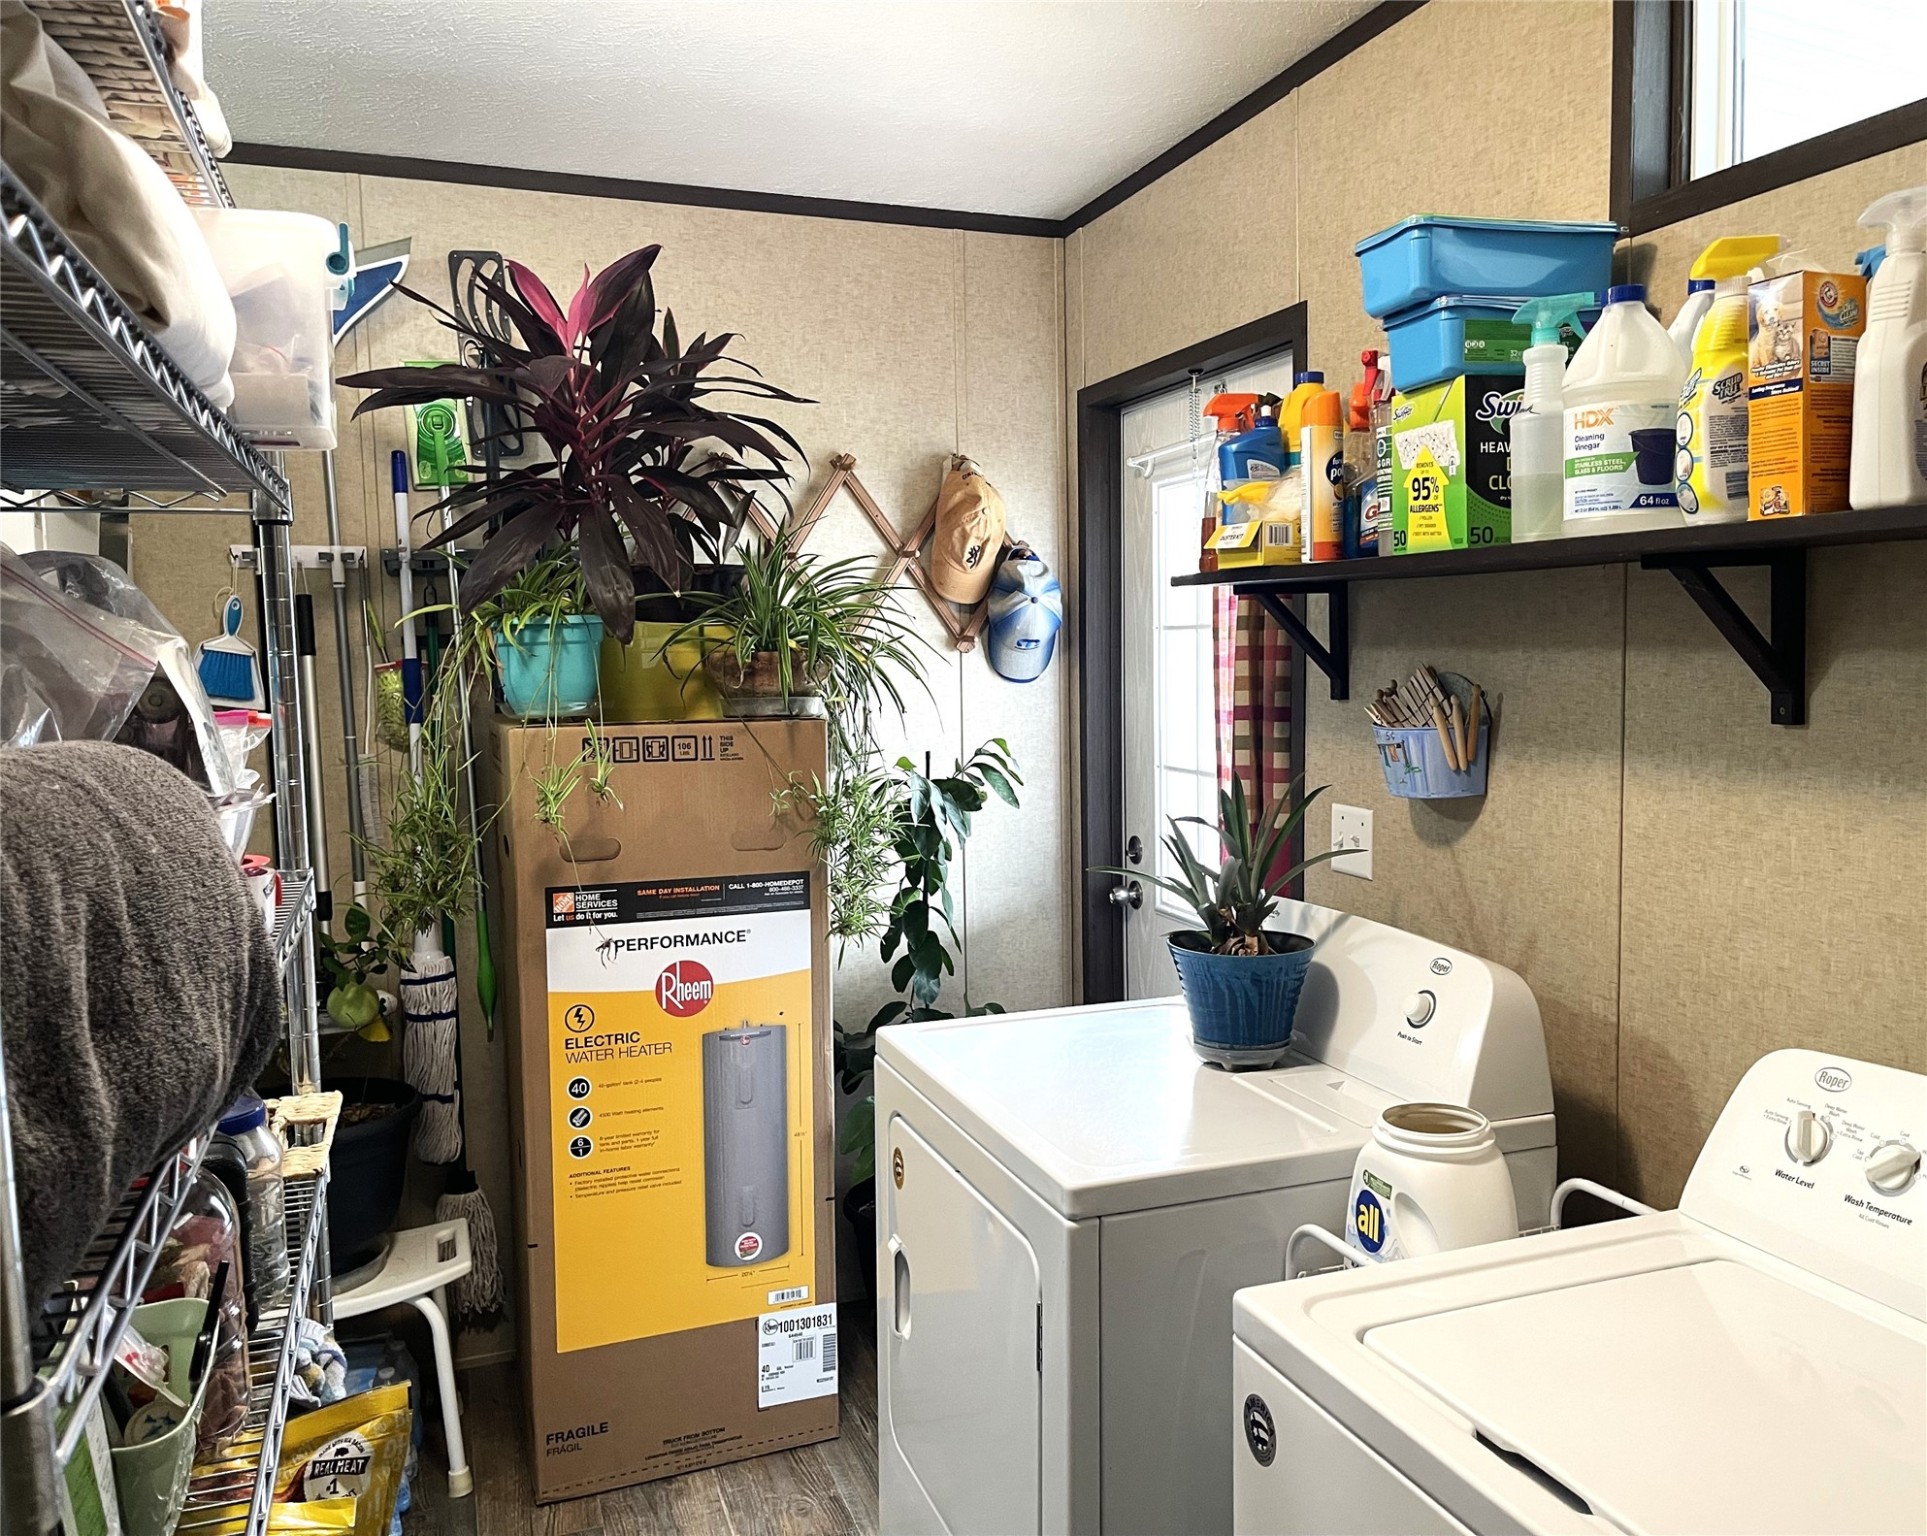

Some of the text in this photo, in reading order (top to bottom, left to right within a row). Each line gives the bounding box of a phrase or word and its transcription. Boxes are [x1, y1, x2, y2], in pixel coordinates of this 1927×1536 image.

[1574, 408, 1614, 430] HDX
[1574, 433, 1605, 444] Cleaning
[1574, 442, 1600, 452] Vinegar
[1575, 460, 1602, 468] STAINLESS
[1597, 464, 1623, 472] FLOORS
[1412, 476, 1439, 501] 95%
[1640, 496, 1653, 506] 64
[1394, 530, 1406, 546] 50
[1470, 526, 1493, 544] 50
[673, 885, 720, 894] INSTALLATION
[576, 900, 618, 909] SERVICES
[1432, 960, 1450, 972] Roper
[661, 961, 711, 1009] Rheem
[565, 1032, 640, 1049] ELECTRIC
[1397, 1031, 1407, 1039] Push
[1412, 1037, 1422, 1045] Start
[566, 1042, 672, 1064] WATER HEATER
[1819, 1071, 1848, 1088] Roper
[571, 1083, 587, 1094] 40
[1775, 1168, 1815, 1189] Water Level
[1844, 1194, 1912, 1226] Wash Temperature
[1358, 1204, 1379, 1242] all
[779, 1314, 833, 1333] 1001301831
[546, 1422, 609, 1445] FRAGILE
[702, 1427, 725, 1436] BOTTOM
[352, 1438, 365, 1453] BACON
[546, 1442, 583, 1457] FRÁGIL
[314, 1460, 364, 1475] REAL MEAT
